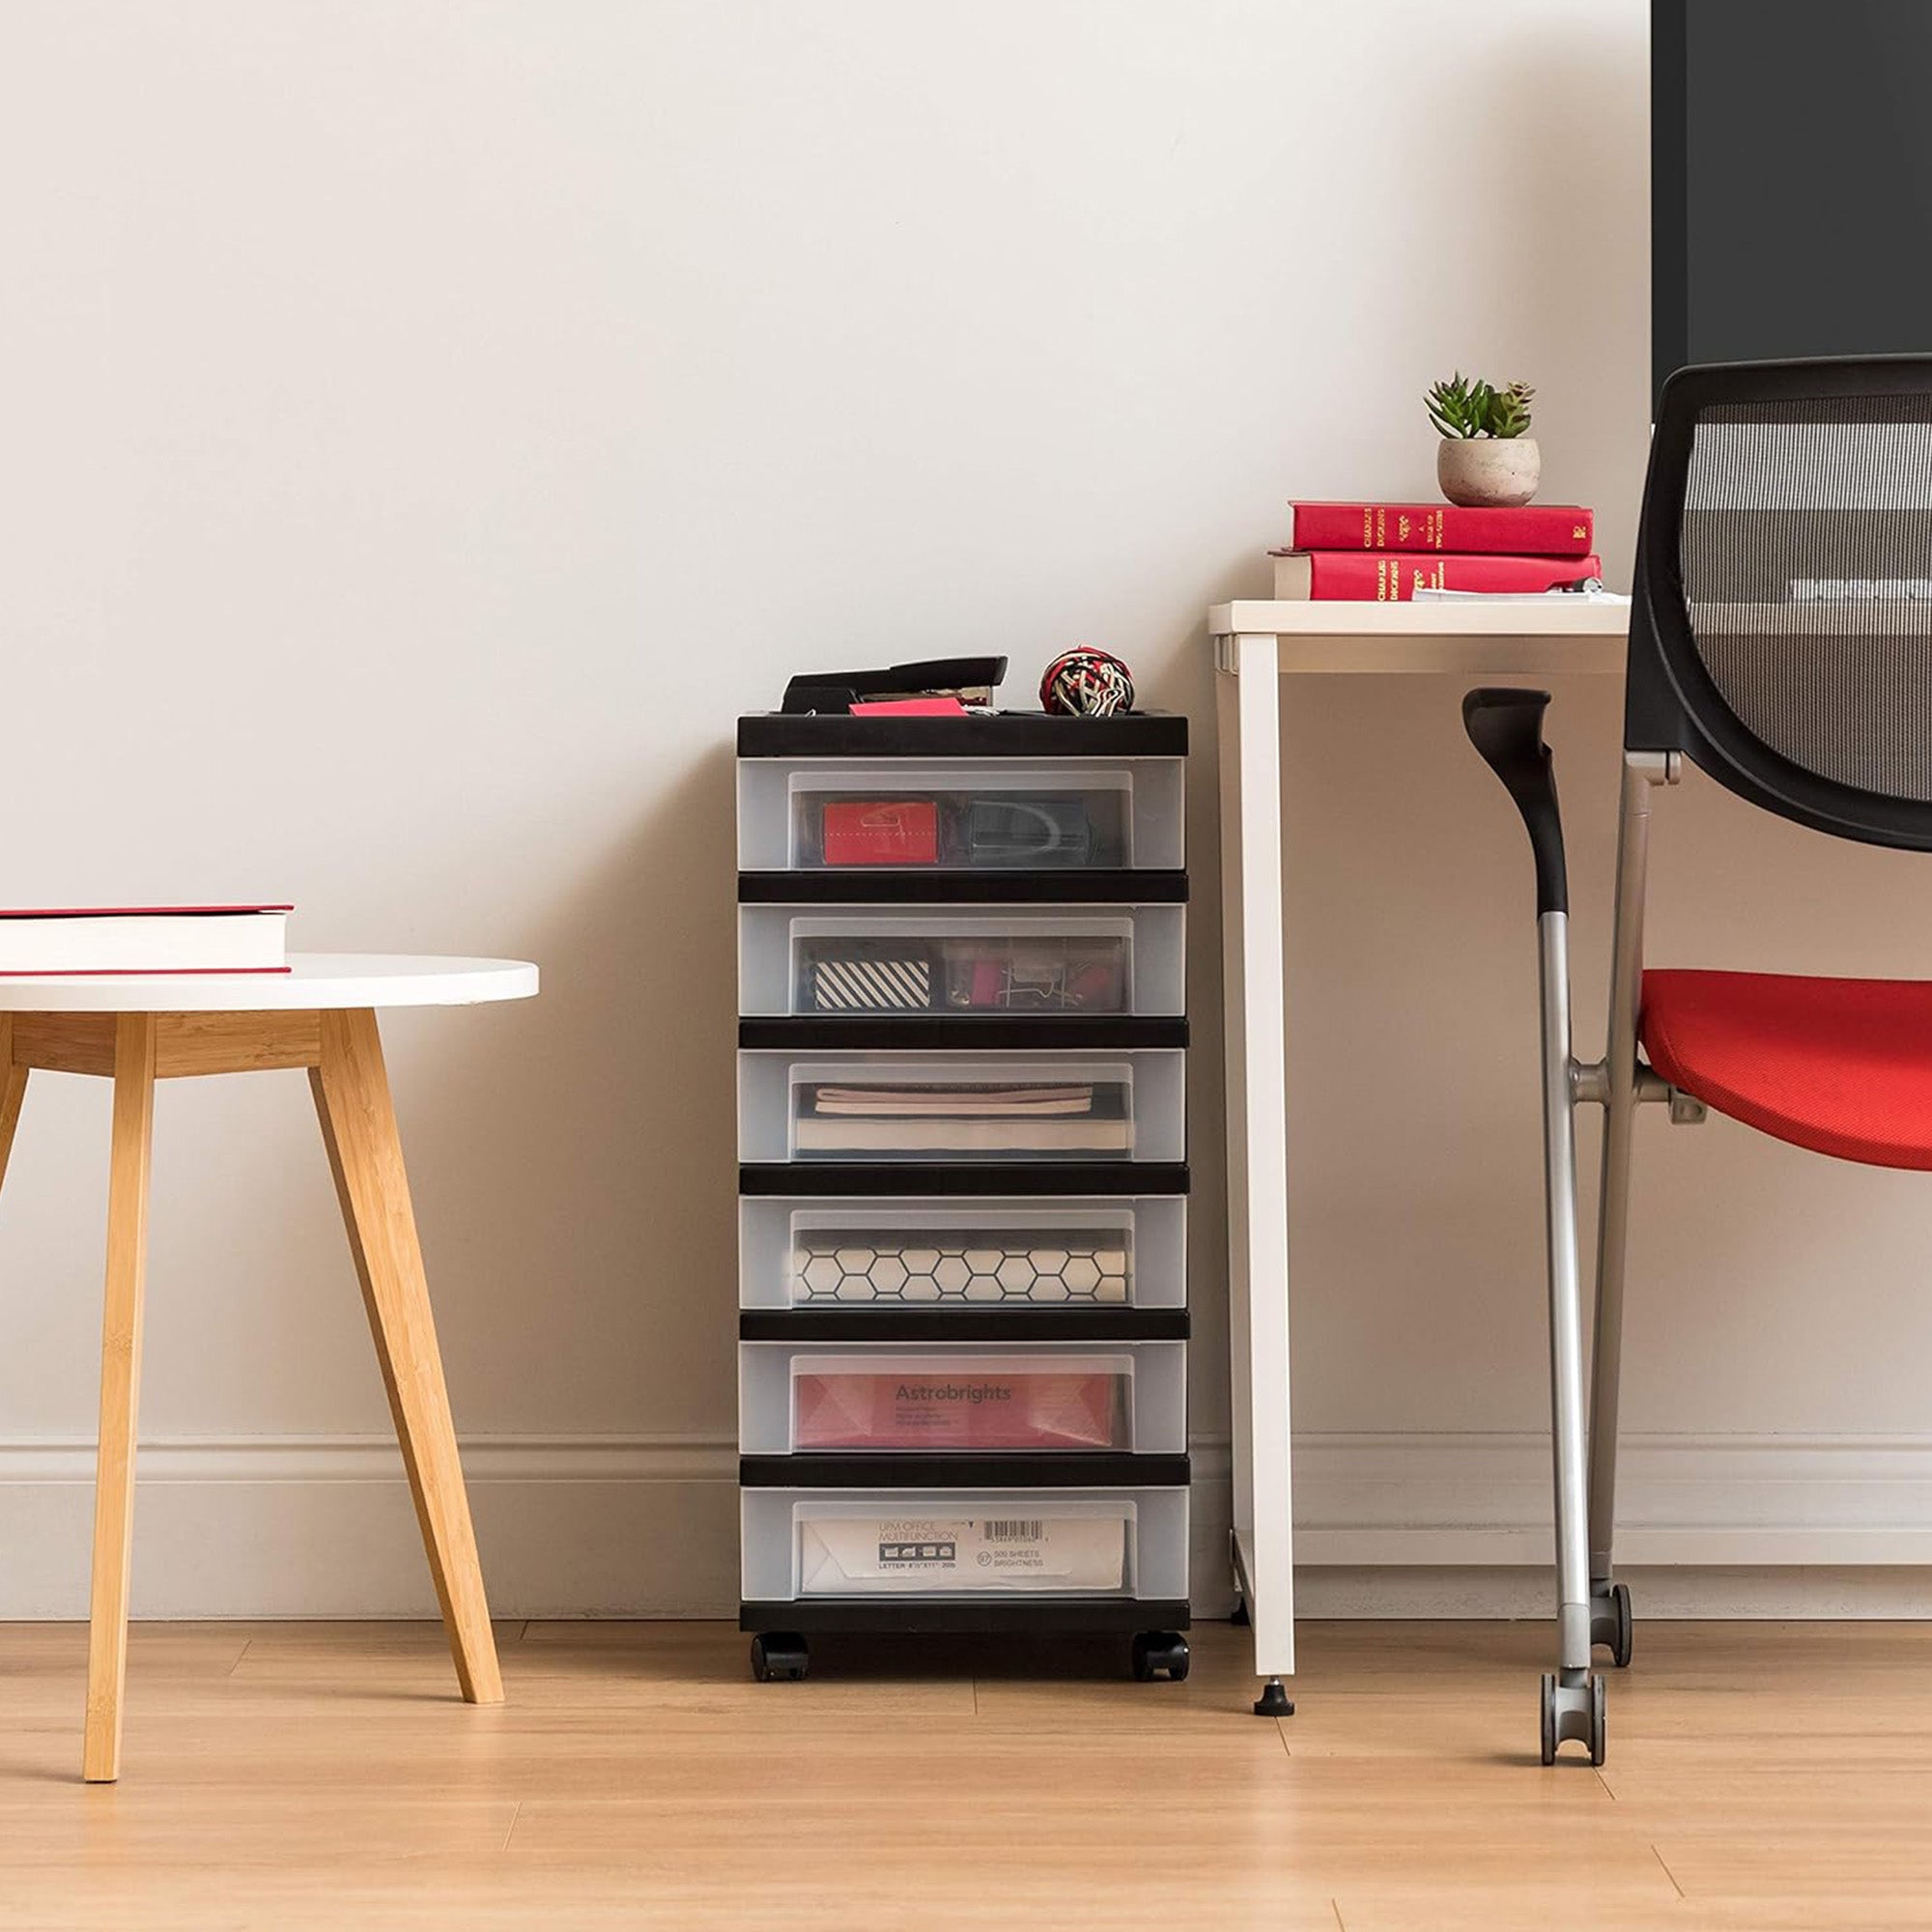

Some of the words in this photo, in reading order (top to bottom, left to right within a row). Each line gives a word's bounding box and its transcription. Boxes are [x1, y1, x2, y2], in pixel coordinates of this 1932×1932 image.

[1378, 560, 1386, 601] CHARLES
[895, 1383, 1010, 1404] Astrobrights
[879, 1531, 958, 1541] MULTIFUNCTION
